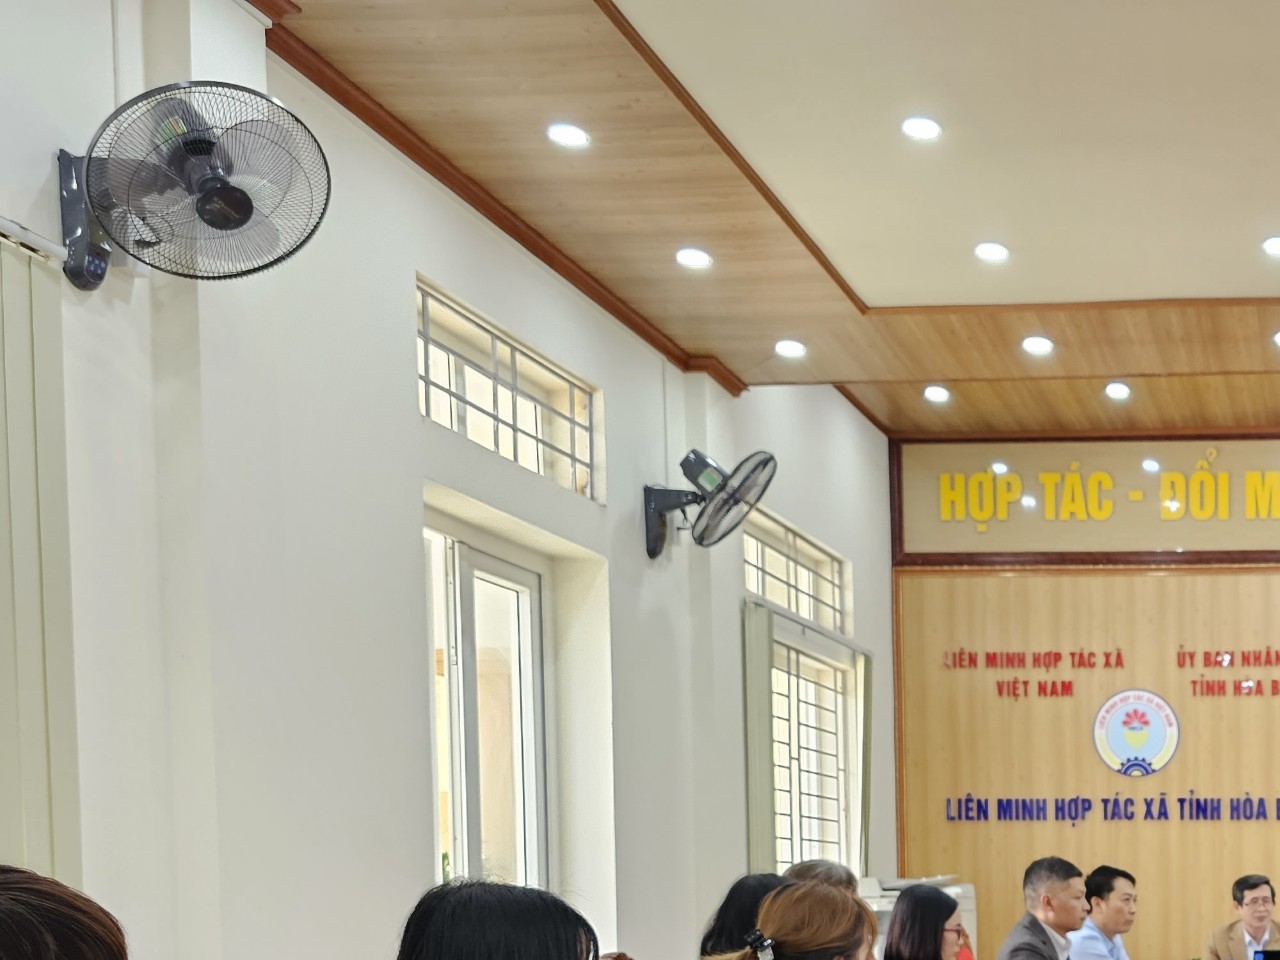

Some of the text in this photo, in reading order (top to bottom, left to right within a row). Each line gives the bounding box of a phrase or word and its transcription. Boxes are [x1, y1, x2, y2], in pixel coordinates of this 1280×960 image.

[940, 465, 1022, 532] HỢP
[1039, 462, 1113, 521] TÁC
[1159, 447, 1229, 520] ĐỔI
[944, 647, 1124, 673] LIÊN MINH HỢP TÁC XÃ
[1177, 644, 1196, 668] ỦY
[996, 676, 1074, 702] VIỆT NAM
[1191, 674, 1226, 696] TỈNH
[946, 793, 989, 821] LIÊN
[997, 798, 1047, 821] MINH
[1055, 795, 1092, 827] HỢP
[1100, 792, 1135, 821] TÁC
[1143, 792, 1169, 821] XÃ
[1177, 789, 1221, 821] TỈNH
[1229, 791, 1268, 821] HÒA
